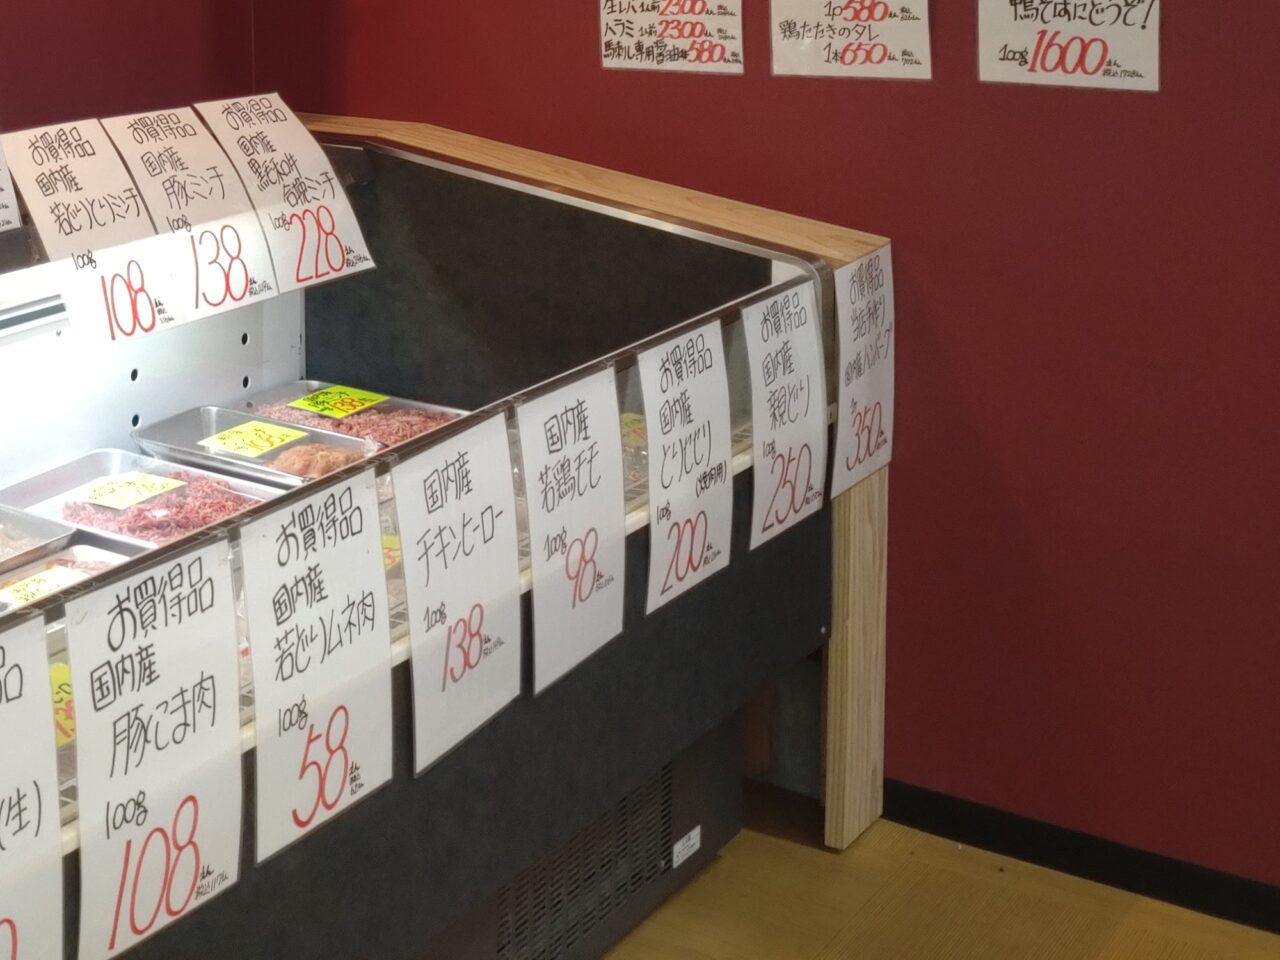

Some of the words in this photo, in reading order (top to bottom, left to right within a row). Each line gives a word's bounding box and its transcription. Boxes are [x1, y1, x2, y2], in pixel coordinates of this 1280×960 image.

[657, 19, 706, 39] 2300
[840, 42, 888, 65] 650
[1027, 29, 1109, 76] 1600
[140, 145, 190, 177] 国内産
[237, 131, 277, 157] 国内産
[35, 164, 84, 198] 国内産
[190, 224, 249, 310] 138
[289, 205, 346, 283] 228
[100, 259, 157, 341] 108
[762, 340, 796, 388] 国内産
[544, 398, 592, 455] 国内産
[659, 389, 694, 436] 国内産
[846, 401, 883, 470] 350
[423, 450, 474, 515] 国内産
[761, 443, 812, 534] 250
[275, 486, 363, 567] お買得品
[660, 510, 709, 596] 200
[106, 556, 215, 652] お買得品
[272, 563, 328, 627] 国内産
[566, 527, 599, 610] 98
[89, 642, 161, 713] 国内産
[441, 603, 485, 693] 138
[109, 669, 217, 779] 豚こま肉
[291, 704, 350, 829] 58
[107, 794, 201, 951] 108
